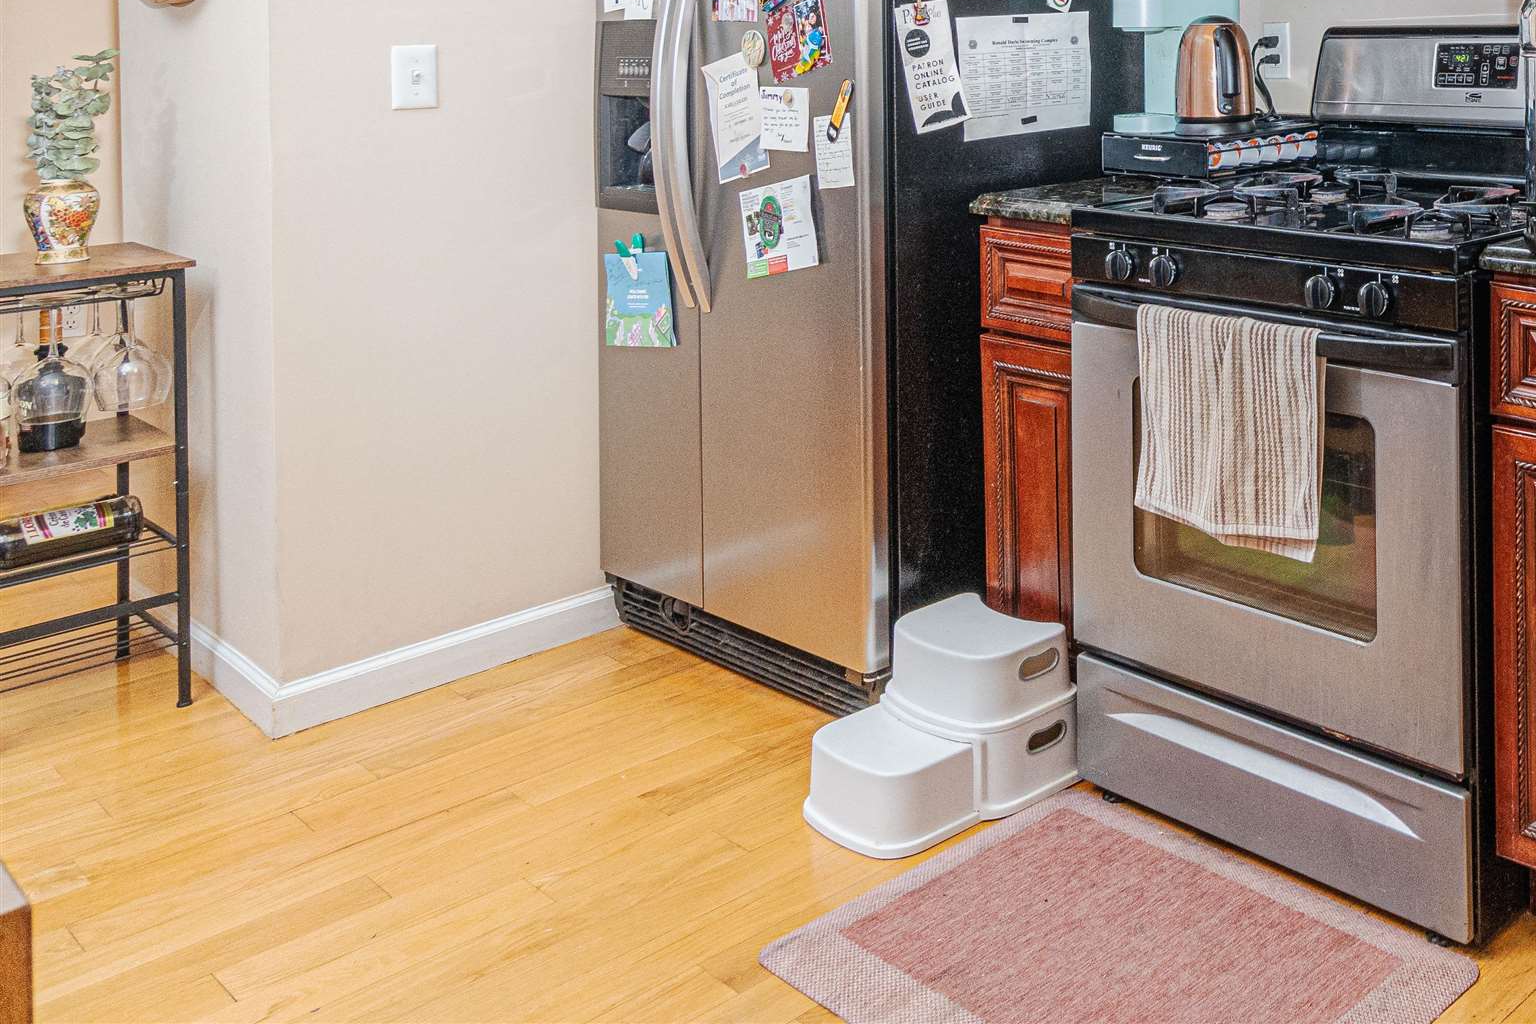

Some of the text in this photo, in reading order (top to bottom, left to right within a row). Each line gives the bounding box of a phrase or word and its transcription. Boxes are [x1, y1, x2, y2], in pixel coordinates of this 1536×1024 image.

[912, 58, 944, 72] PATRON
[719, 67, 748, 83] Certificate
[913, 68, 943, 81] ONLINE
[730, 78, 738, 87] of
[915, 75, 955, 90] CATALOG
[719, 83, 751, 100] Completion
[918, 92, 938, 103] USER
[920, 99, 946, 111] GUIDE
[1141, 143, 1163, 152] KEURIG
